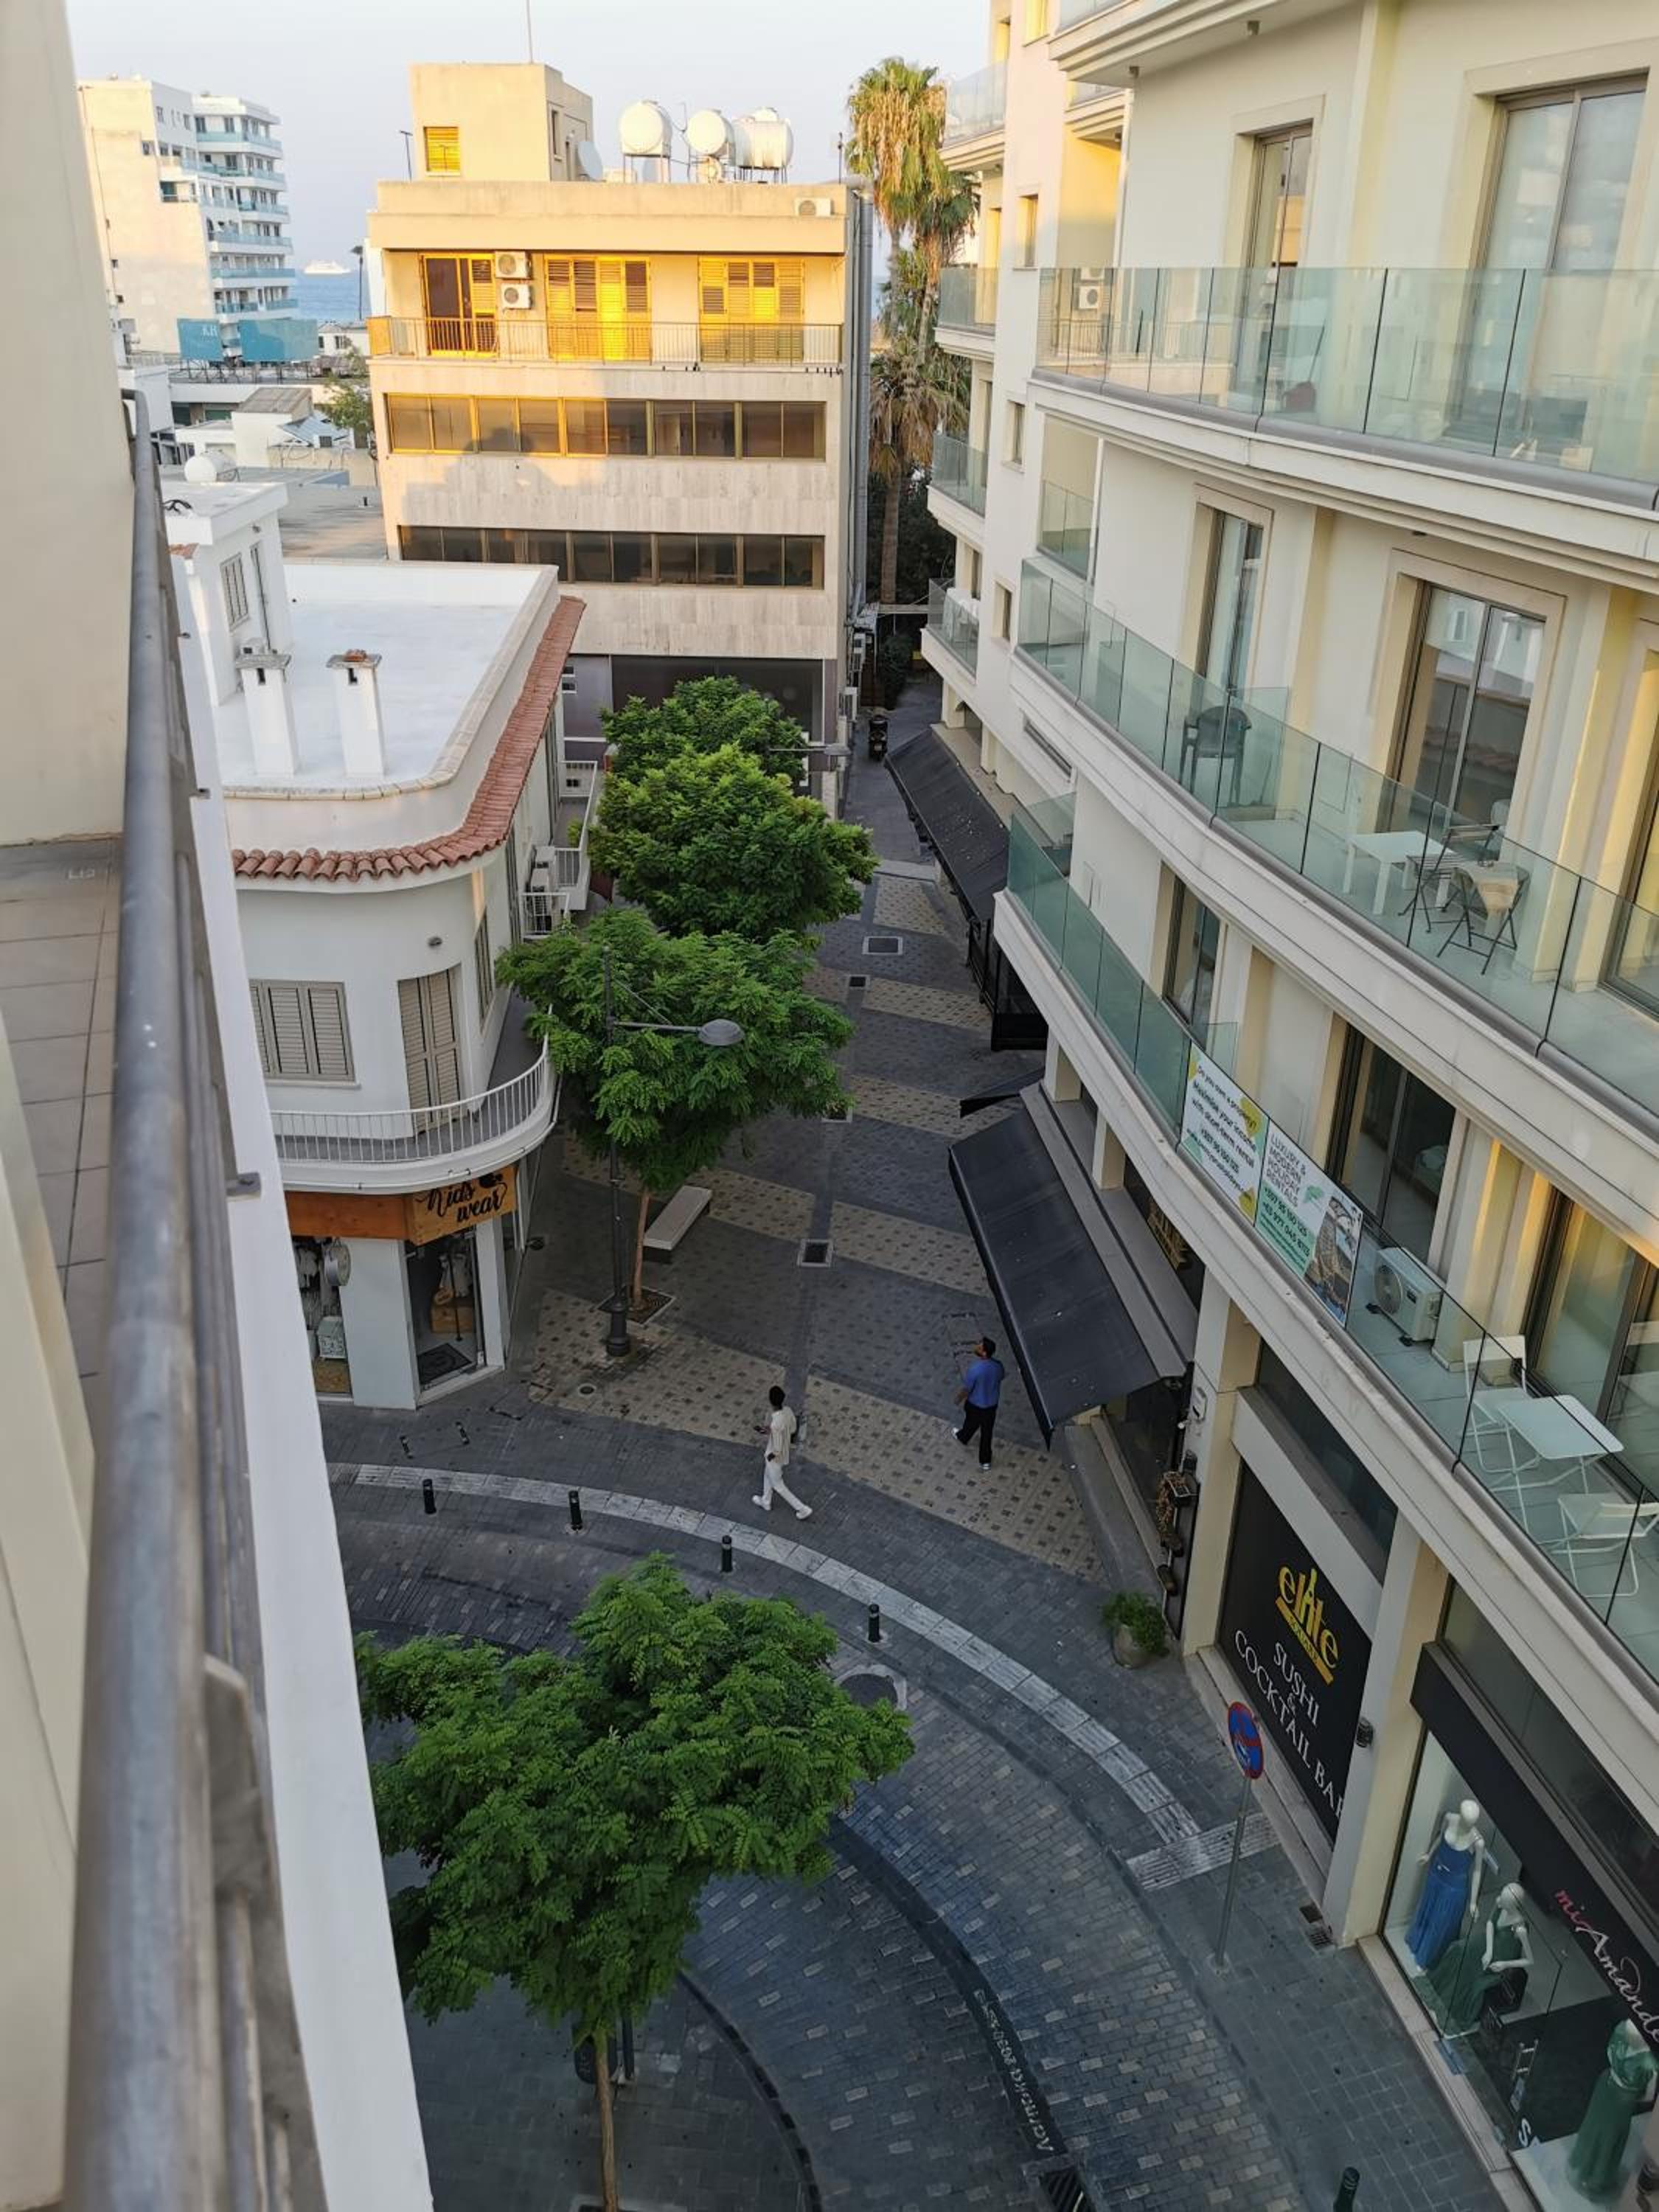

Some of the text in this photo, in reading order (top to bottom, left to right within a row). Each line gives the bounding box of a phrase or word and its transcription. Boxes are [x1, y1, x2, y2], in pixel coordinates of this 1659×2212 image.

[1192, 1094, 1203, 1116] with
[1205, 1071, 1214, 1090] you
[1214, 1082, 1225, 1099] own
[1219, 1108, 1233, 1131] your
[1233, 1121, 1256, 1153] income
[1269, 1144, 1301, 1186] MODERN
[1270, 1132, 1306, 1177] LUXURY &
[1266, 1166, 1298, 1209] RENTALS
[1267, 1155, 1300, 1197] HOLIDAY
[456, 1182, 507, 1222] wear
[1235, 1630, 1311, 1769] COCKTAIL
[1273, 1642, 1319, 1726] SUSHI
